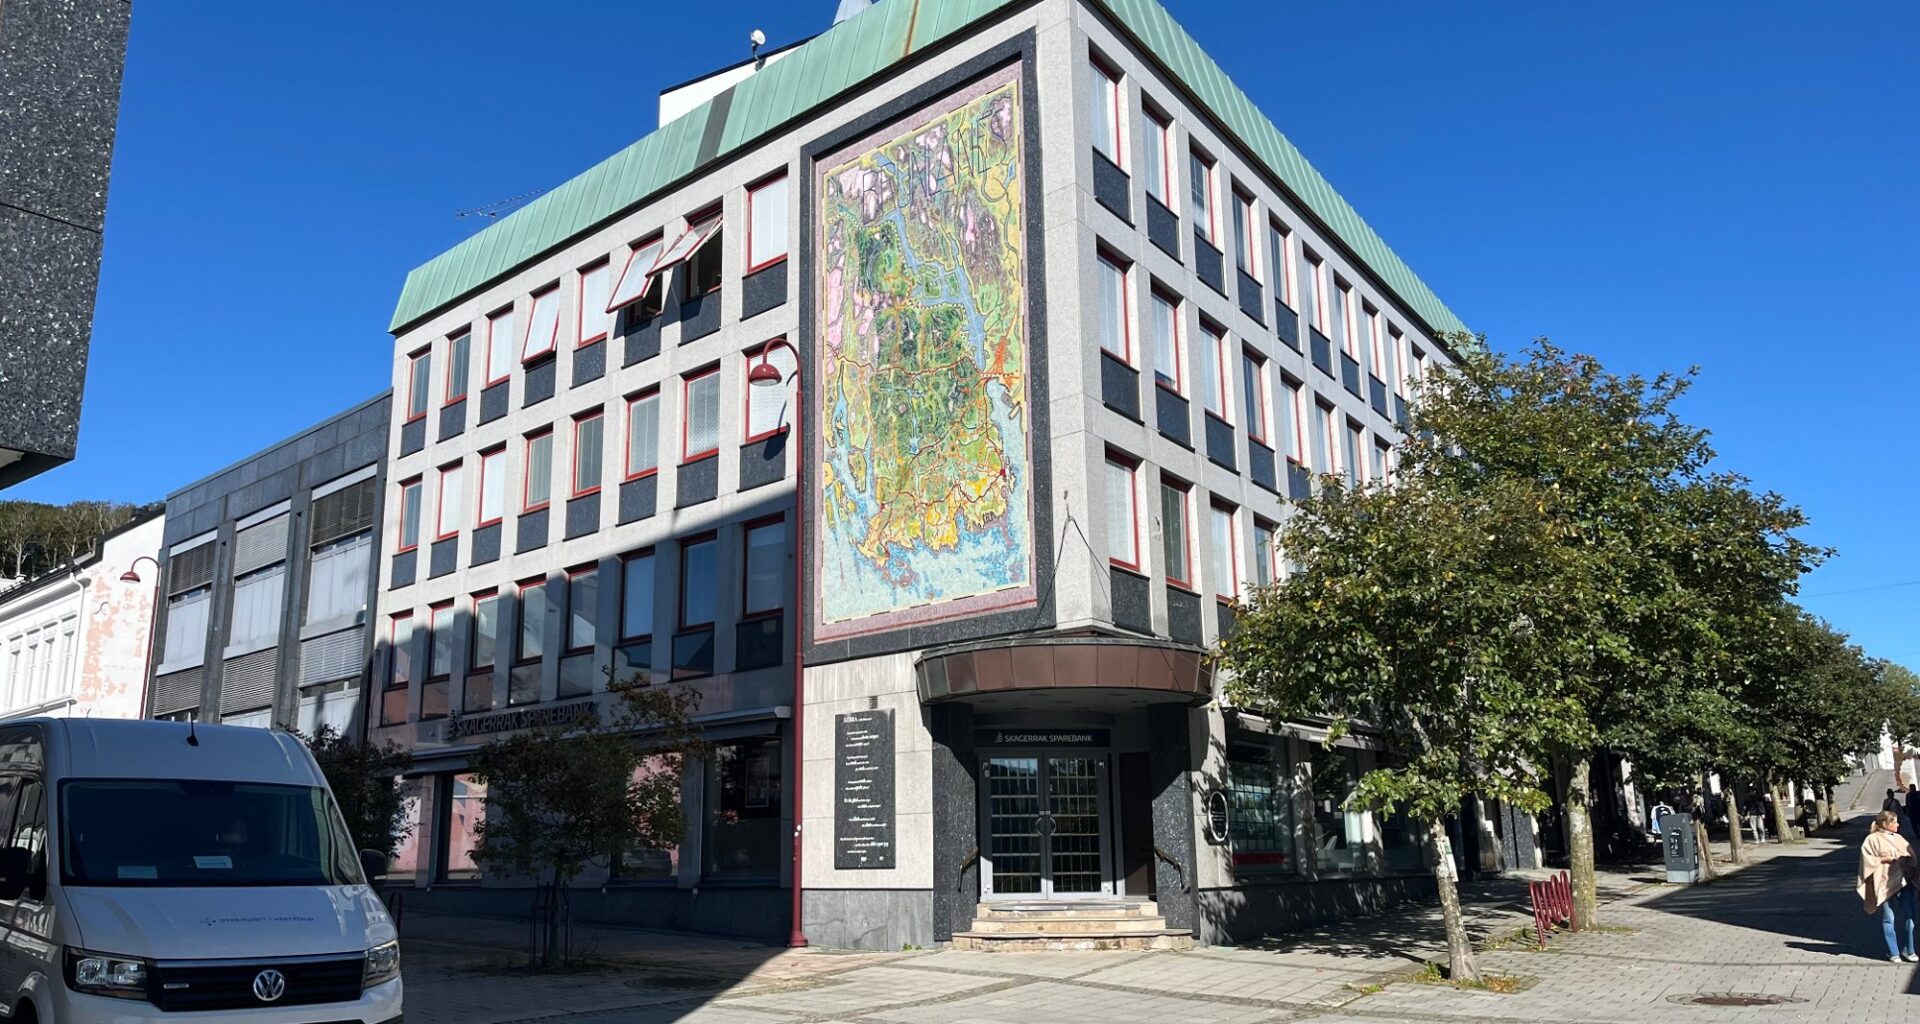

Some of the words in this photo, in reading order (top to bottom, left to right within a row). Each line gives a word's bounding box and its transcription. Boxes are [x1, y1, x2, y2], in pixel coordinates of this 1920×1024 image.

[456, 712, 519, 737] SKAGERRAK
[1004, 734, 1047, 742] SKAGERRAK
[1049, 734, 1093, 742] SPAREBANK
